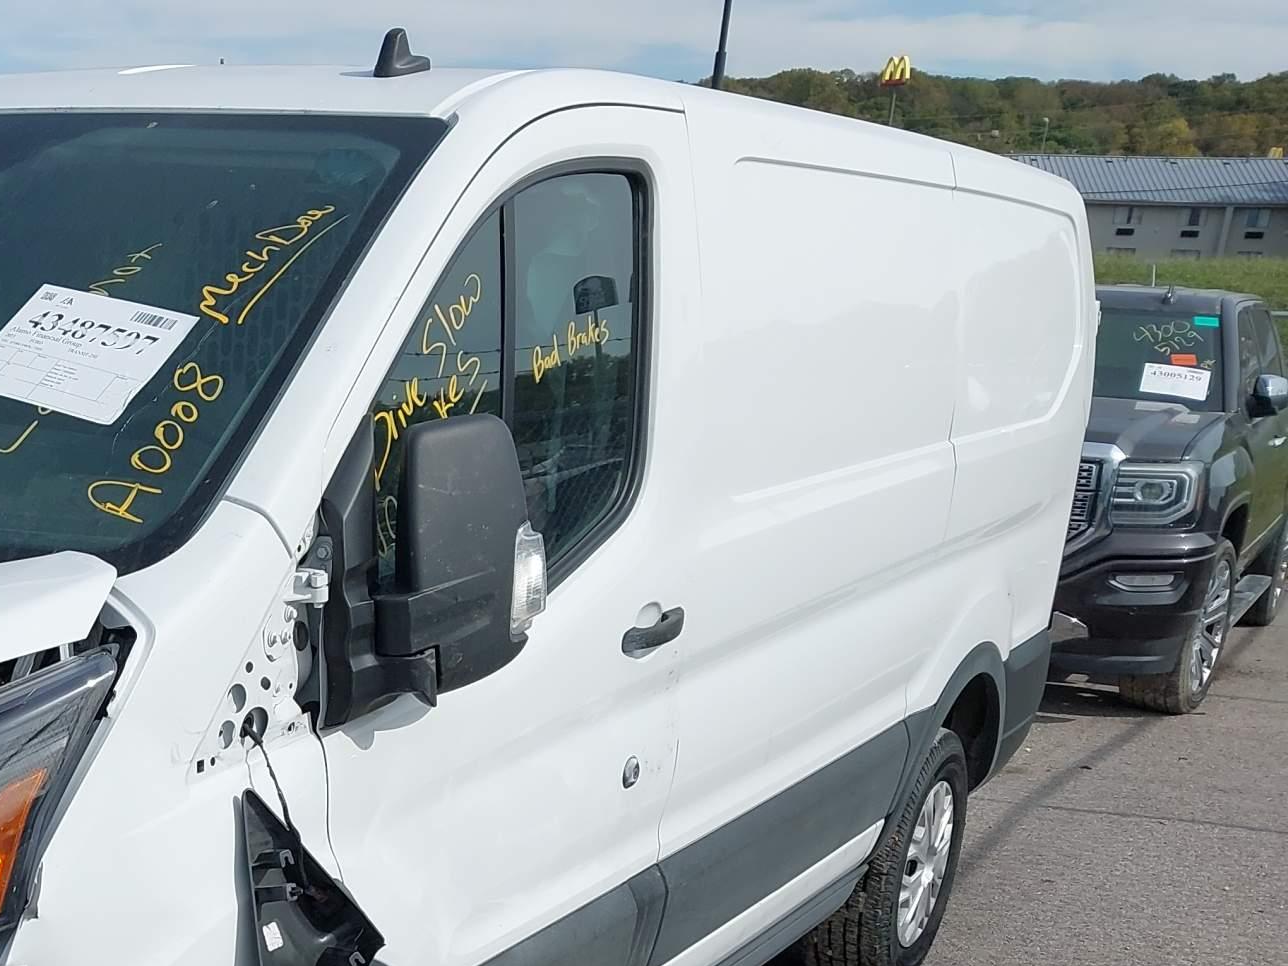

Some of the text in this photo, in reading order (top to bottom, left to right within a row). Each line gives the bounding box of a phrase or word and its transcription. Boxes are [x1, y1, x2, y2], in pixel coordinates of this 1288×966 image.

[199, 245, 281, 325] Mech
[28, 310, 160, 355] 43487597
[422, 273, 481, 378] Slow
[532, 315, 609, 384] Bad Brakes
[1133, 320, 1191, 343] 4300
[1154, 331, 1205, 356] 5129
[1150, 369, 1203, 382] 43005129
[87, 361, 225, 524] A0008
